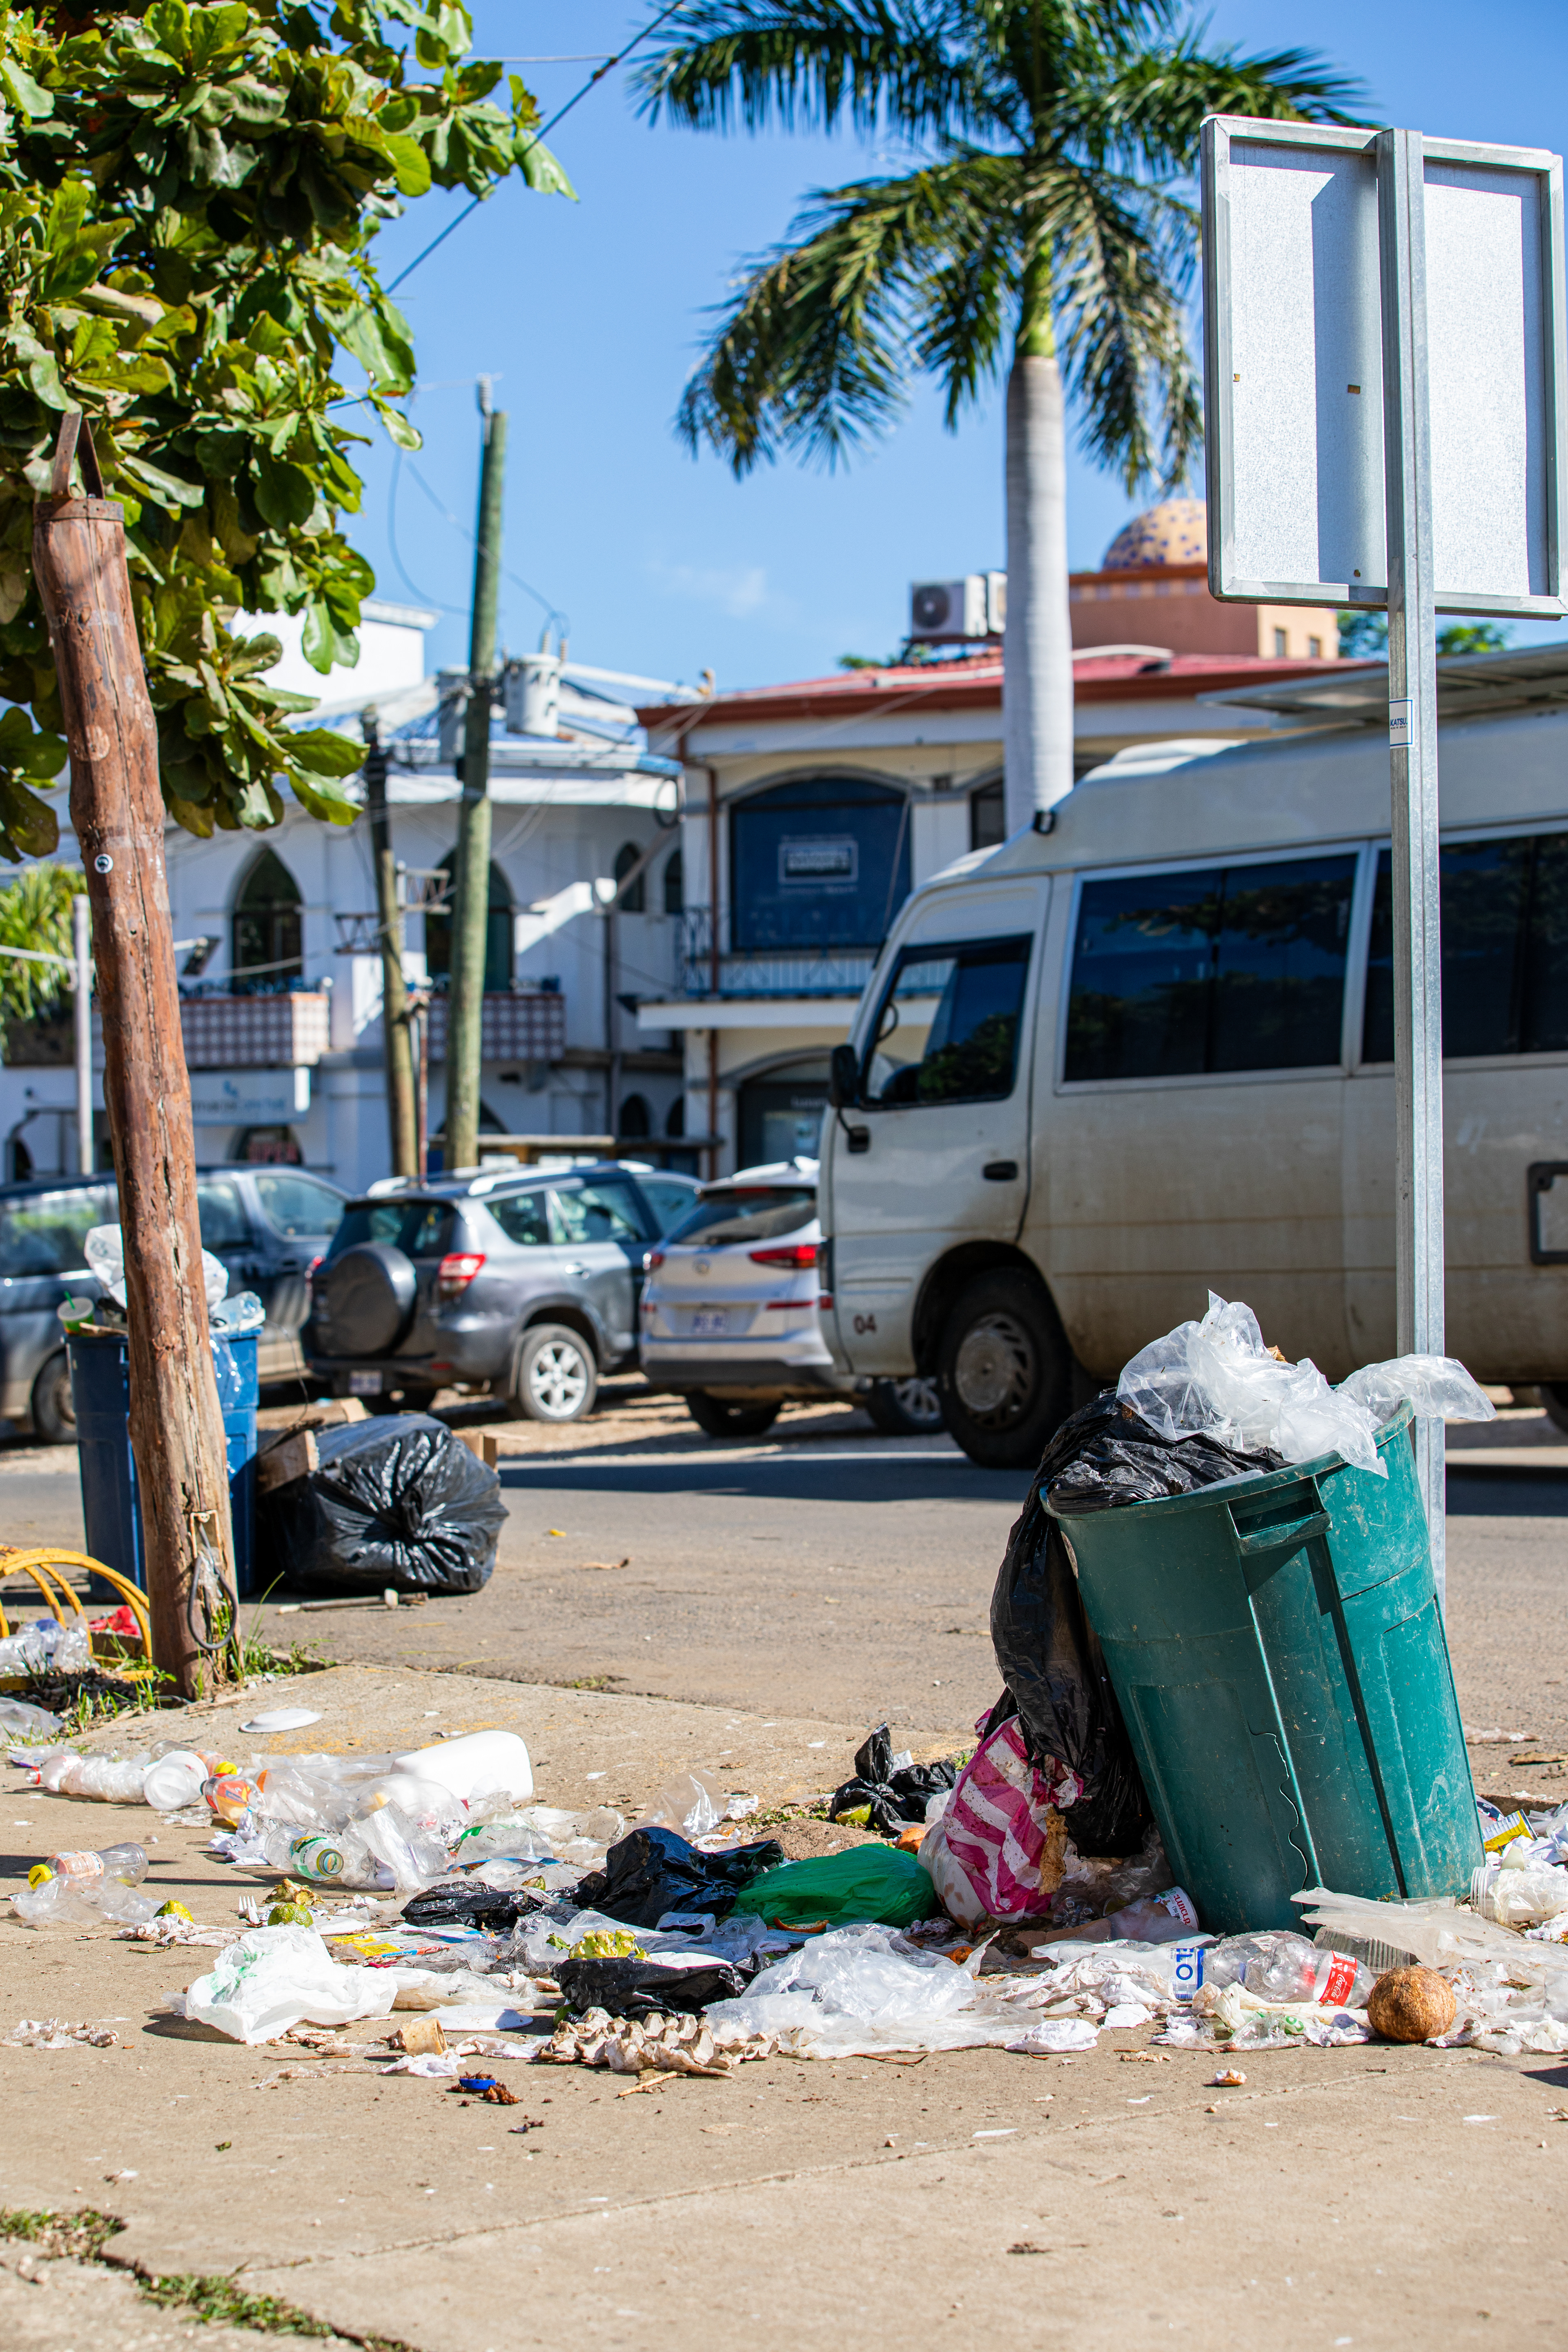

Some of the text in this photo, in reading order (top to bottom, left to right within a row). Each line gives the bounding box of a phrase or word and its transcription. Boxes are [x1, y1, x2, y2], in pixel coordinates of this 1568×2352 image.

[1390, 717, 1408, 726] KATSU.
[853, 1314, 877, 1336] 04
[31, 1872, 42, 1886] fuzetea
